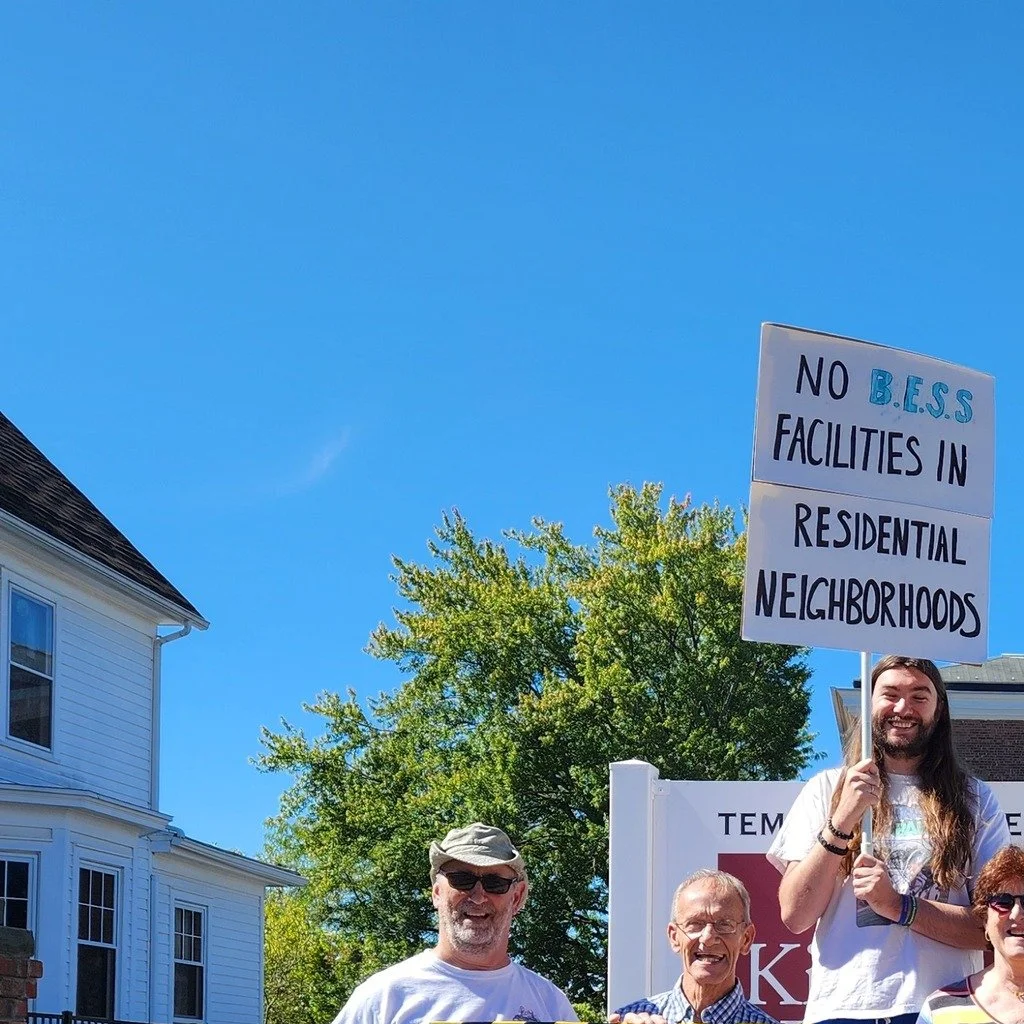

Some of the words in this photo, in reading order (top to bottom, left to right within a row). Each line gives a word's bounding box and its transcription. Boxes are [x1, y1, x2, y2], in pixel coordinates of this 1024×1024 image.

[796, 355, 849, 400] NO
[868, 368, 974, 424] B.E.S.S
[773, 413, 923, 476] FACILITIES
[937, 440, 967, 486] IN
[794, 503, 966, 565] RESIDENTIAL
[755, 569, 981, 638] NEIGHBORHOODS
